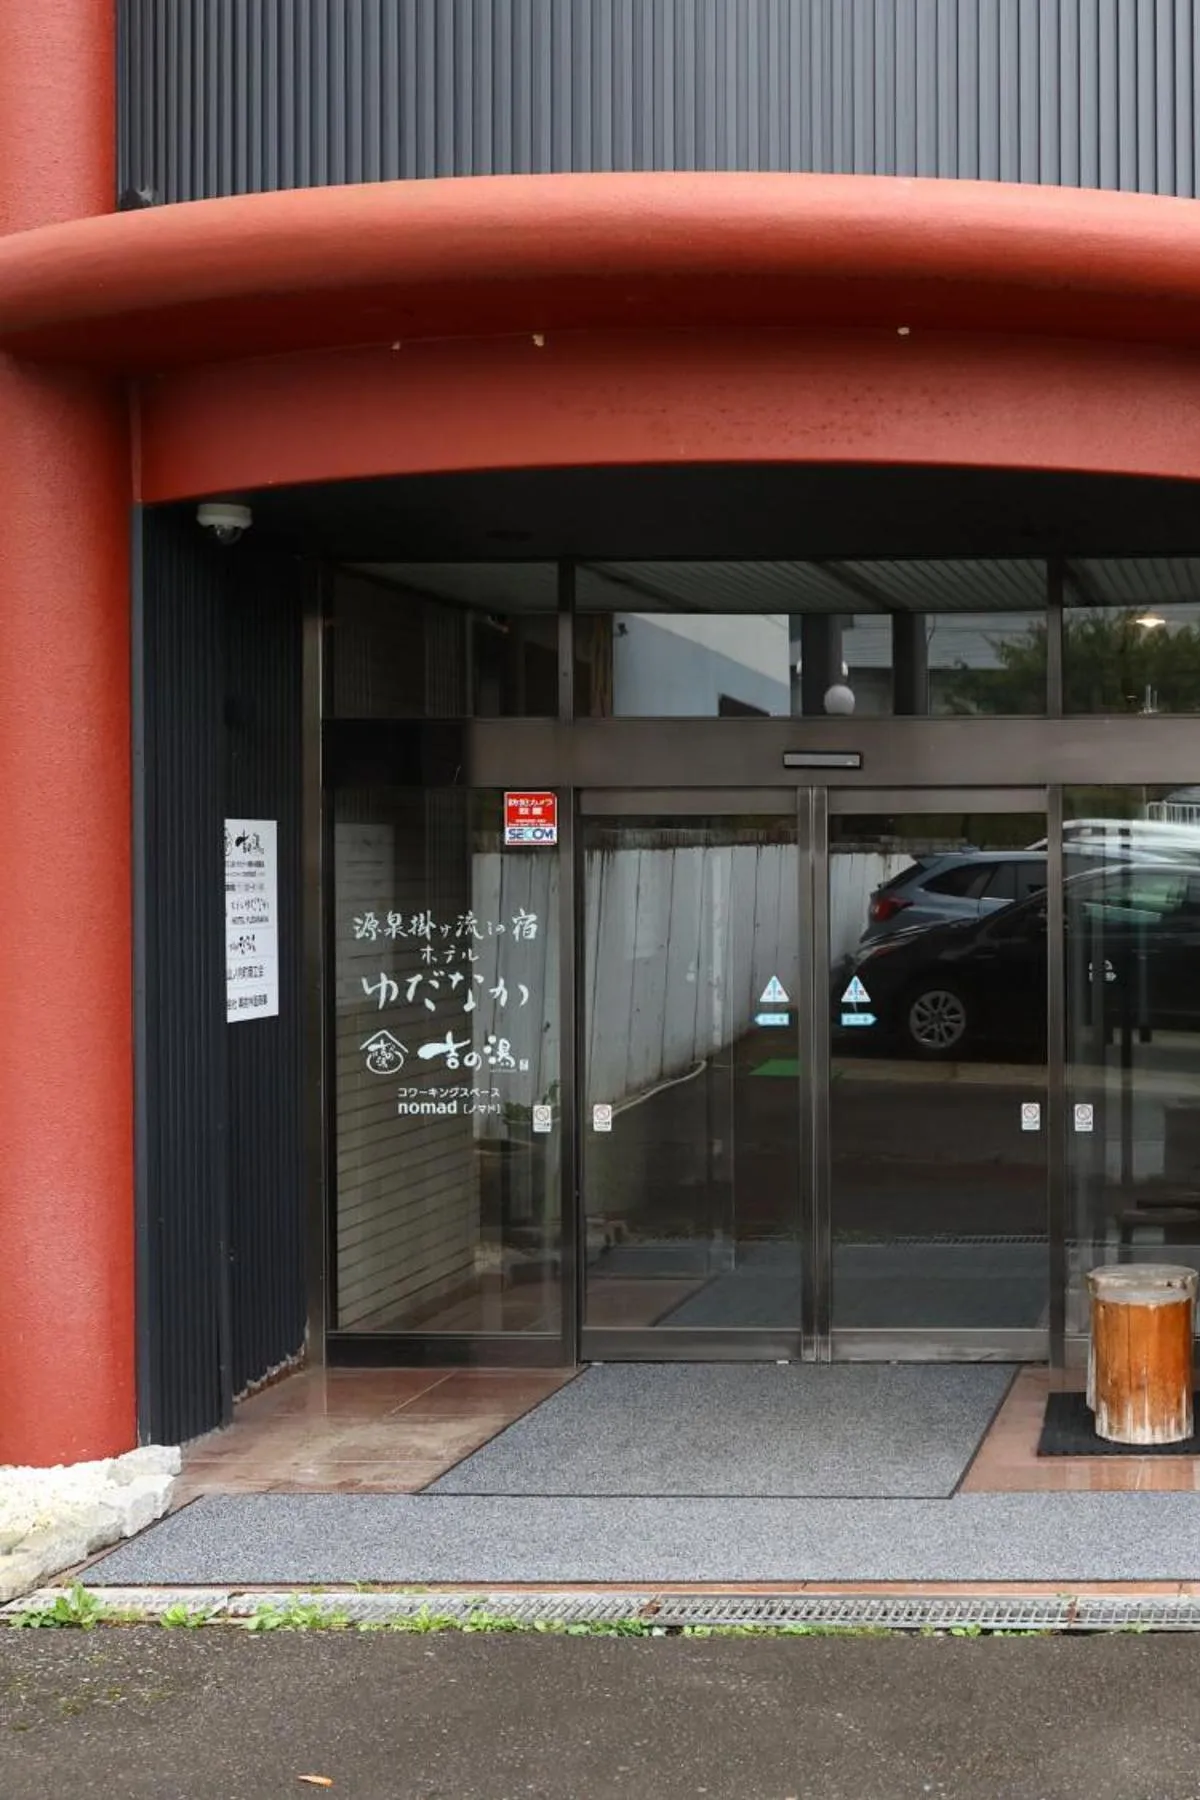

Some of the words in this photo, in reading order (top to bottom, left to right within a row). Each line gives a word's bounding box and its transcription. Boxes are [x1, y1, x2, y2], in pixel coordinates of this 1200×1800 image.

[508, 828, 554, 840] SECOM
[420, 944, 480, 965] ホテル
[361, 971, 530, 1013] ゆだなか
[416, 1030, 516, 1072] 吉の湯
[397, 1087, 501, 1098] コワーキングスペース
[398, 1100, 458, 1115] nomad
